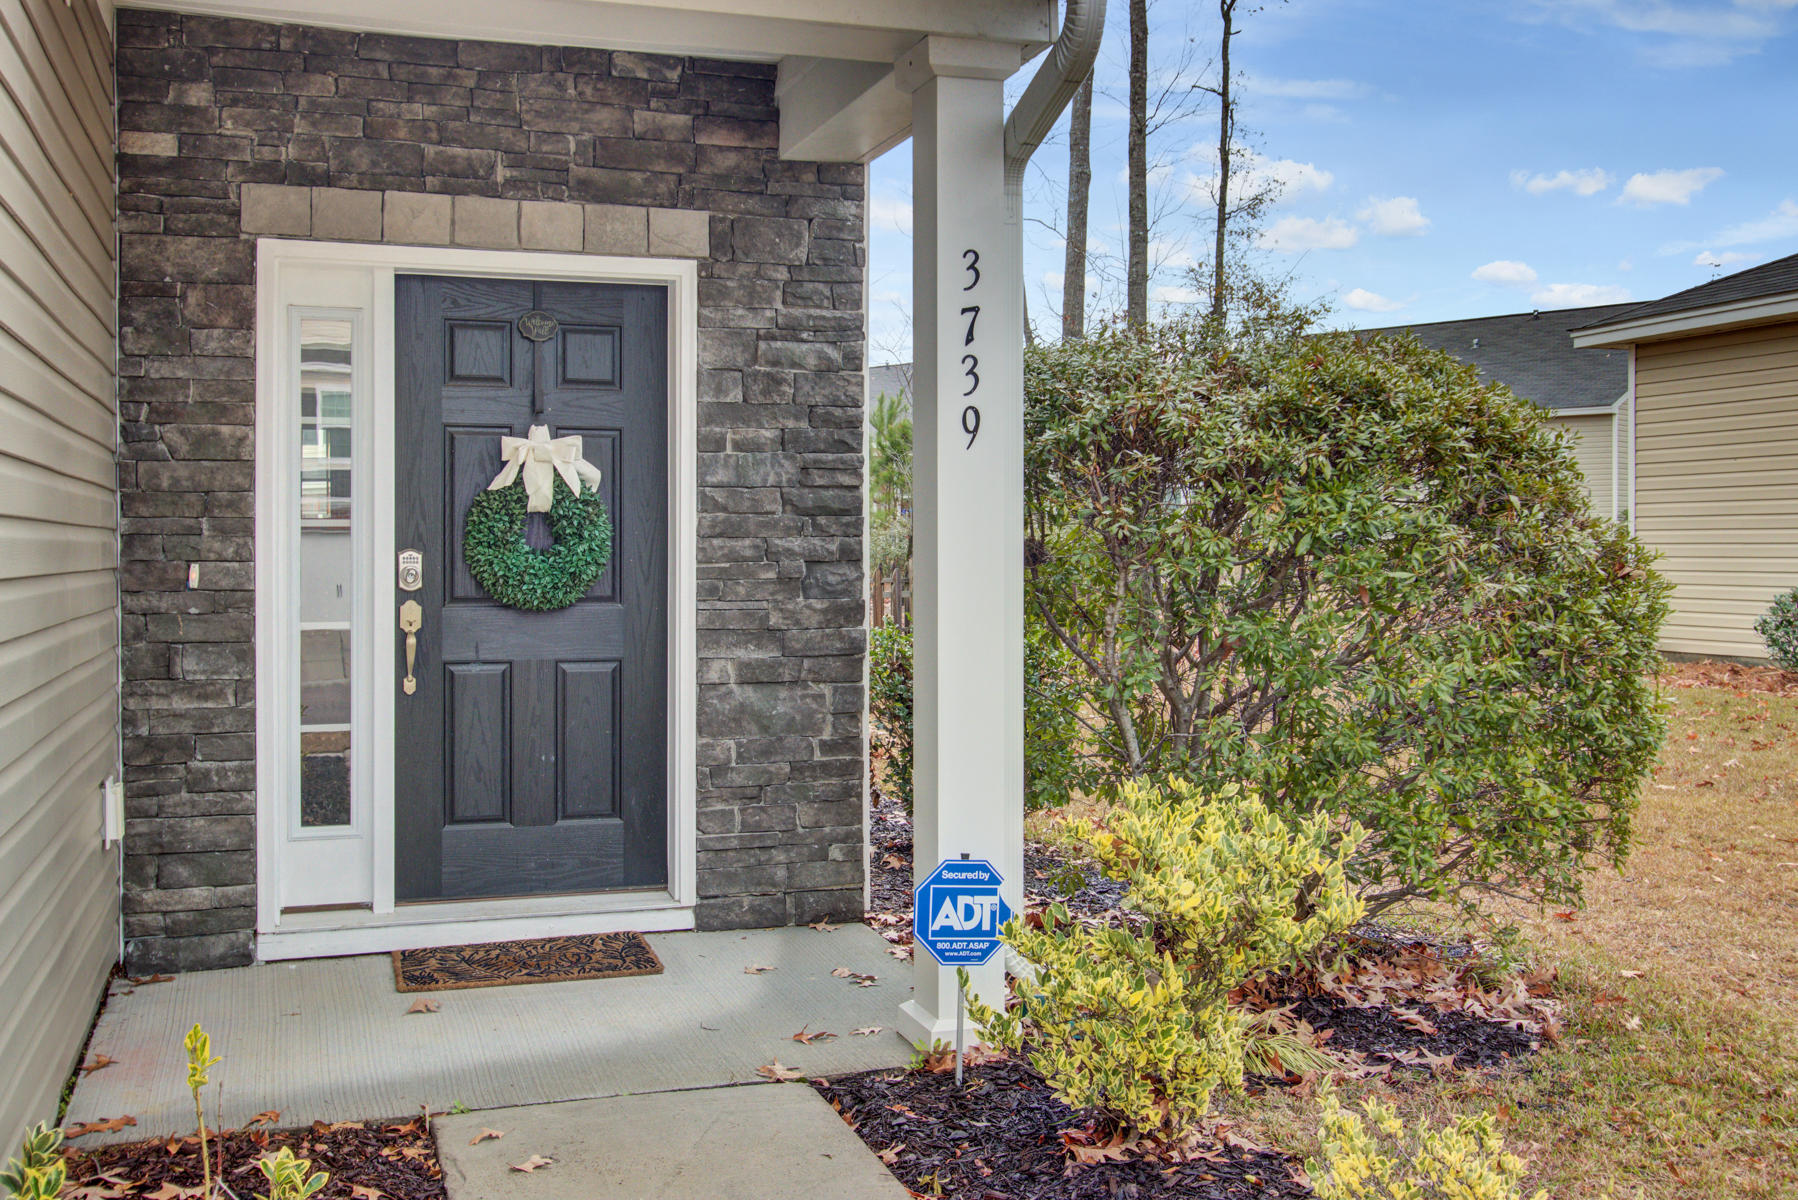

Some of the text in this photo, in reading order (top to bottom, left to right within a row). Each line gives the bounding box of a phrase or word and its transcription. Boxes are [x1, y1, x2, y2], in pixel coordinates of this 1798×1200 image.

[961, 249, 981, 450] 3739
[942, 870, 990, 881] Secured by
[931, 895, 998, 931] ADT
[936, 942, 990, 950] 800.ADT.ASAP
